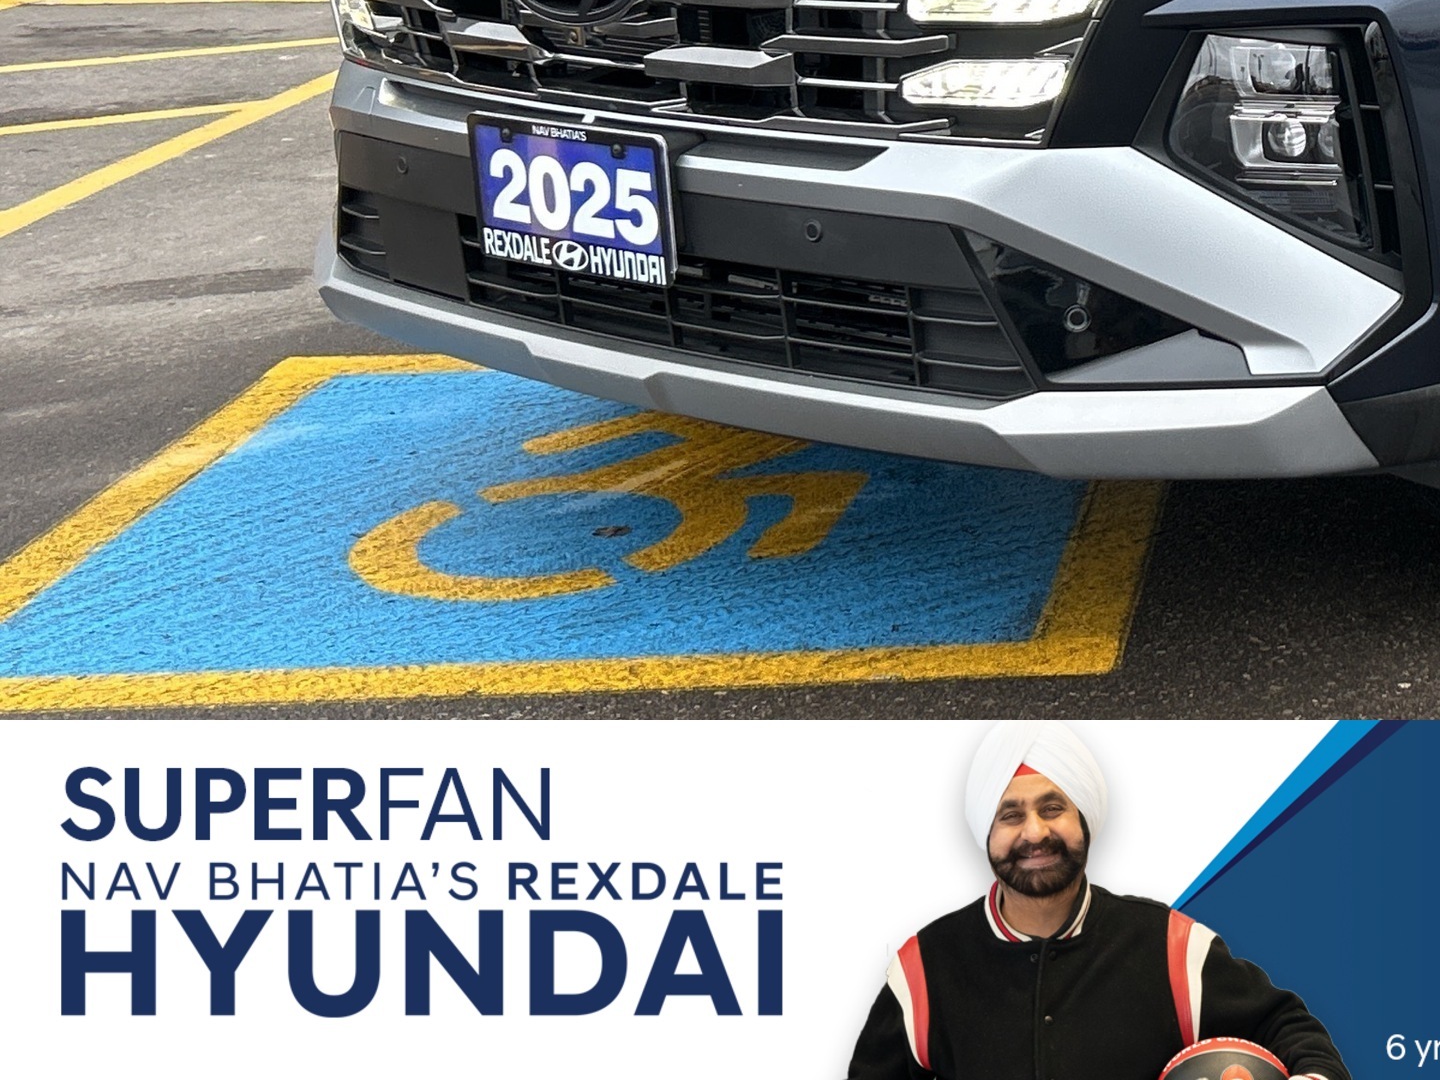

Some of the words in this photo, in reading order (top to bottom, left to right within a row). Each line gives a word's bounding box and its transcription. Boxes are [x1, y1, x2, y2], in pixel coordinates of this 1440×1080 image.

[532, 124, 551, 137] NAV
[551, 126, 588, 142] BHATIA'S
[489, 148, 659, 246] 2025
[482, 227, 552, 265] REXDALE
[589, 244, 667, 286] HYUNDAI
